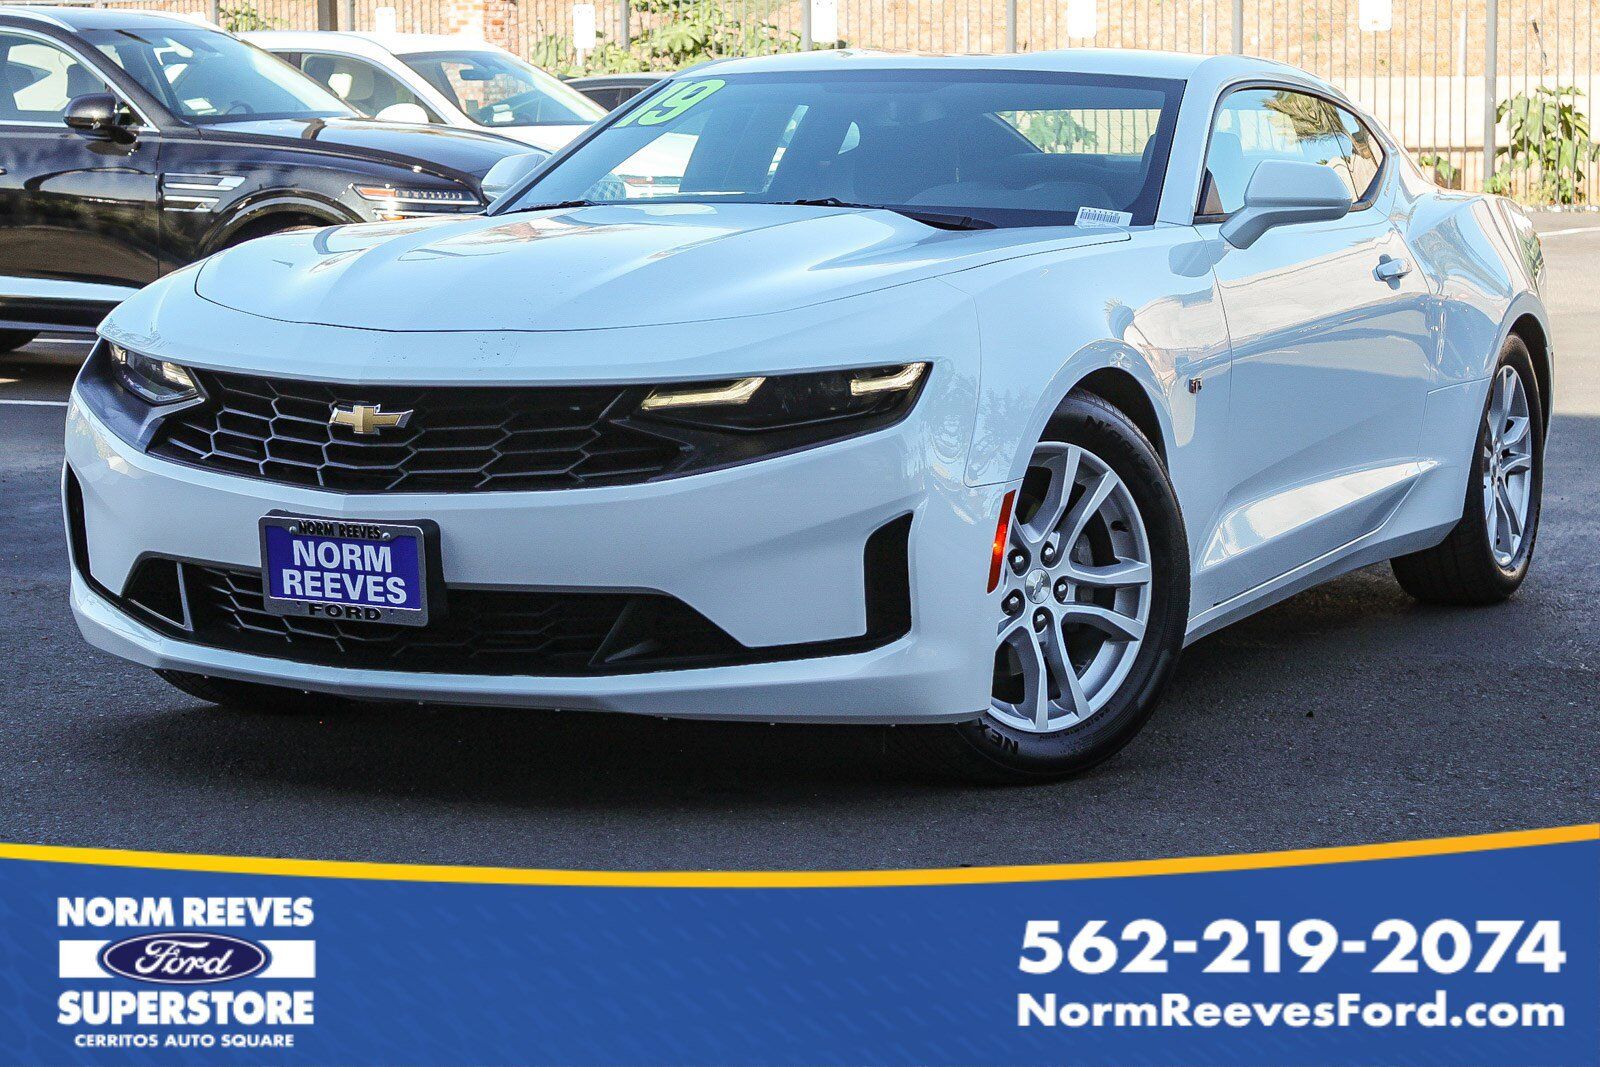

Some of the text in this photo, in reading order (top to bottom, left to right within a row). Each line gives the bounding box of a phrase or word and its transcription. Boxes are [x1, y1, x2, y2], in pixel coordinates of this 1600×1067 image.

[612, 79, 726, 127] 19
[299, 520, 381, 540] NORM REEVES
[293, 540, 392, 573] NORM
[282, 569, 407, 604] REEVES
[308, 604, 382, 621] FORD
